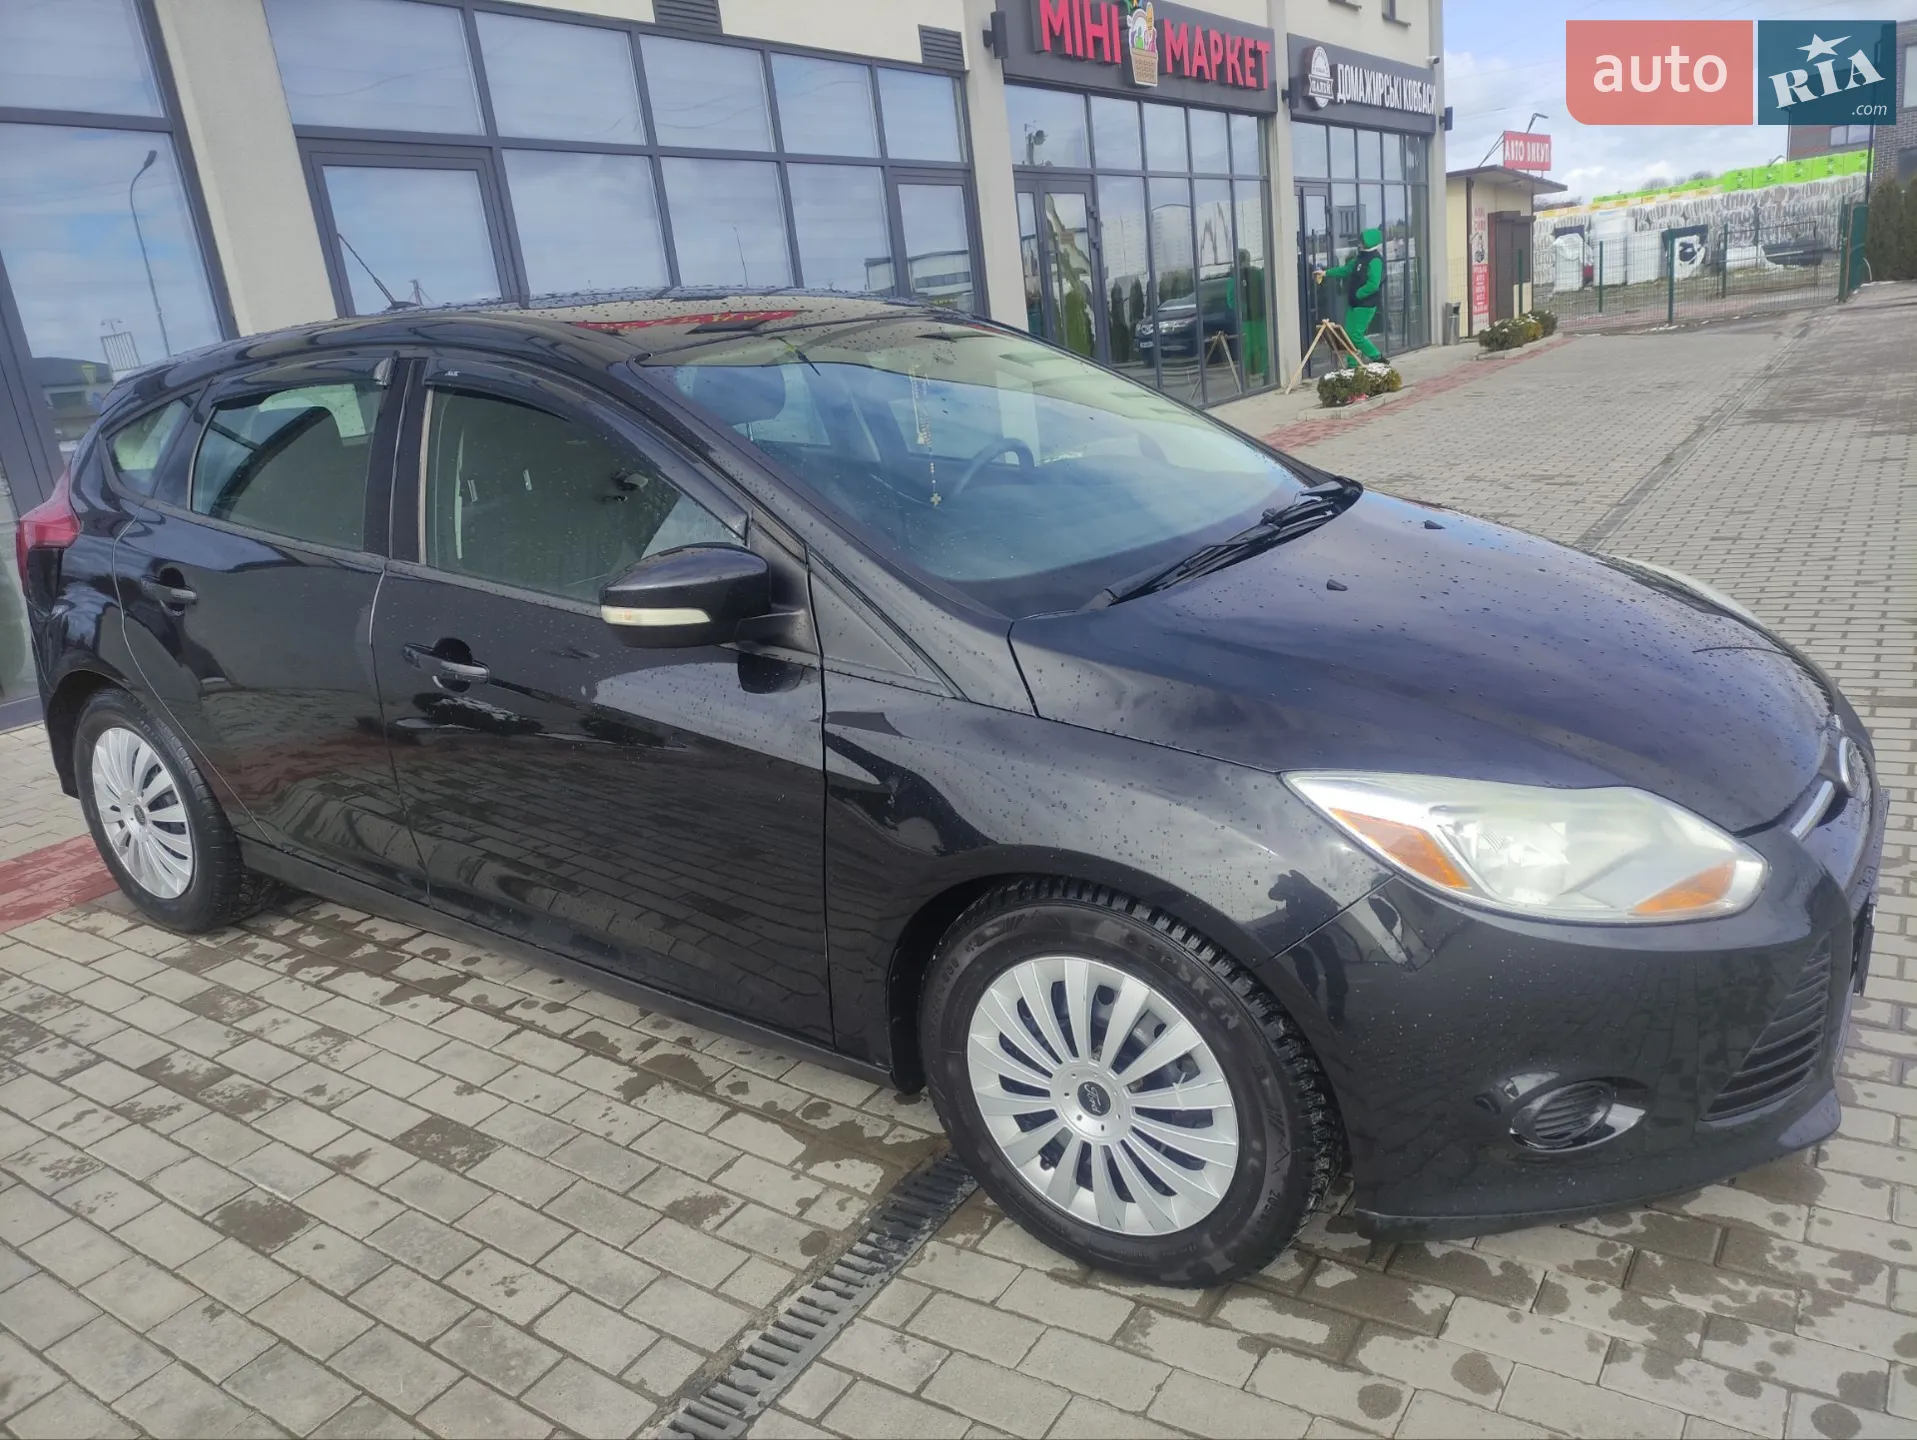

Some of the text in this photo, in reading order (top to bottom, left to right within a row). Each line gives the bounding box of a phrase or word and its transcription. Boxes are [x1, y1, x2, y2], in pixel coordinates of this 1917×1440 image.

[1039, 0, 1122, 64] МІНІ
[1163, 18, 1271, 90] МАРКЕТ
[1337, 63, 1402, 109] ДОМАЖИРСЬКІ
